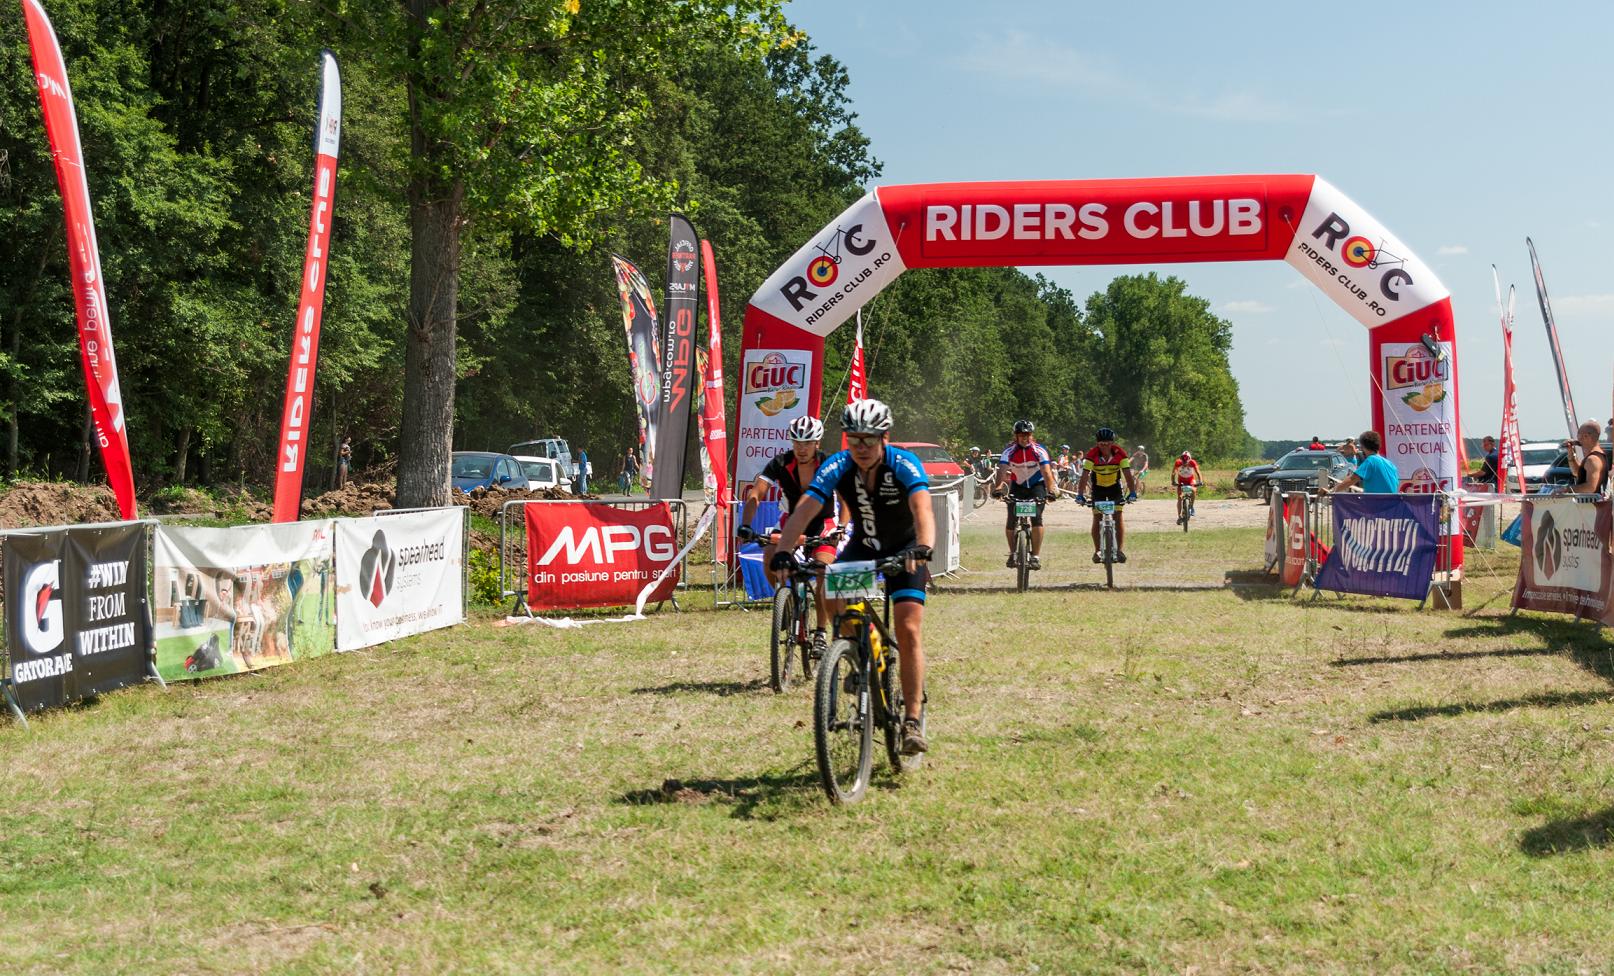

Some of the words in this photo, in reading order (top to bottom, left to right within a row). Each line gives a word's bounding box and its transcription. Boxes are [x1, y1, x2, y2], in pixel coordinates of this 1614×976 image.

[925, 202, 1110, 242] RIDERS
[1123, 198, 1263, 240] CLUB
[805, 291, 845, 326] RIDERS
[843, 267, 873, 294] CLUB
[873, 251, 892, 271] .RO
[1298, 242, 1339, 276] RIDERS
[1337, 274, 1367, 301] CLUB
[1365, 301, 1386, 317] .RO
[742, 427, 790, 441] PARTENE
[1388, 422, 1450, 436] PARTENER
[745, 445, 790, 458] OFICIA
[1397, 442, 1447, 455] OFICIAL
[398, 535, 445, 572] spearhead
[536, 525, 675, 566] MPG
[88, 560, 130, 588] #WIN
[534, 571, 556, 584] din
[561, 571, 609, 584] pasiune
[614, 569, 648, 583] pentru
[89, 592, 126, 622] FROM
[79, 622, 135, 656] WITHIN
[14, 652, 73, 684] GATORAE
